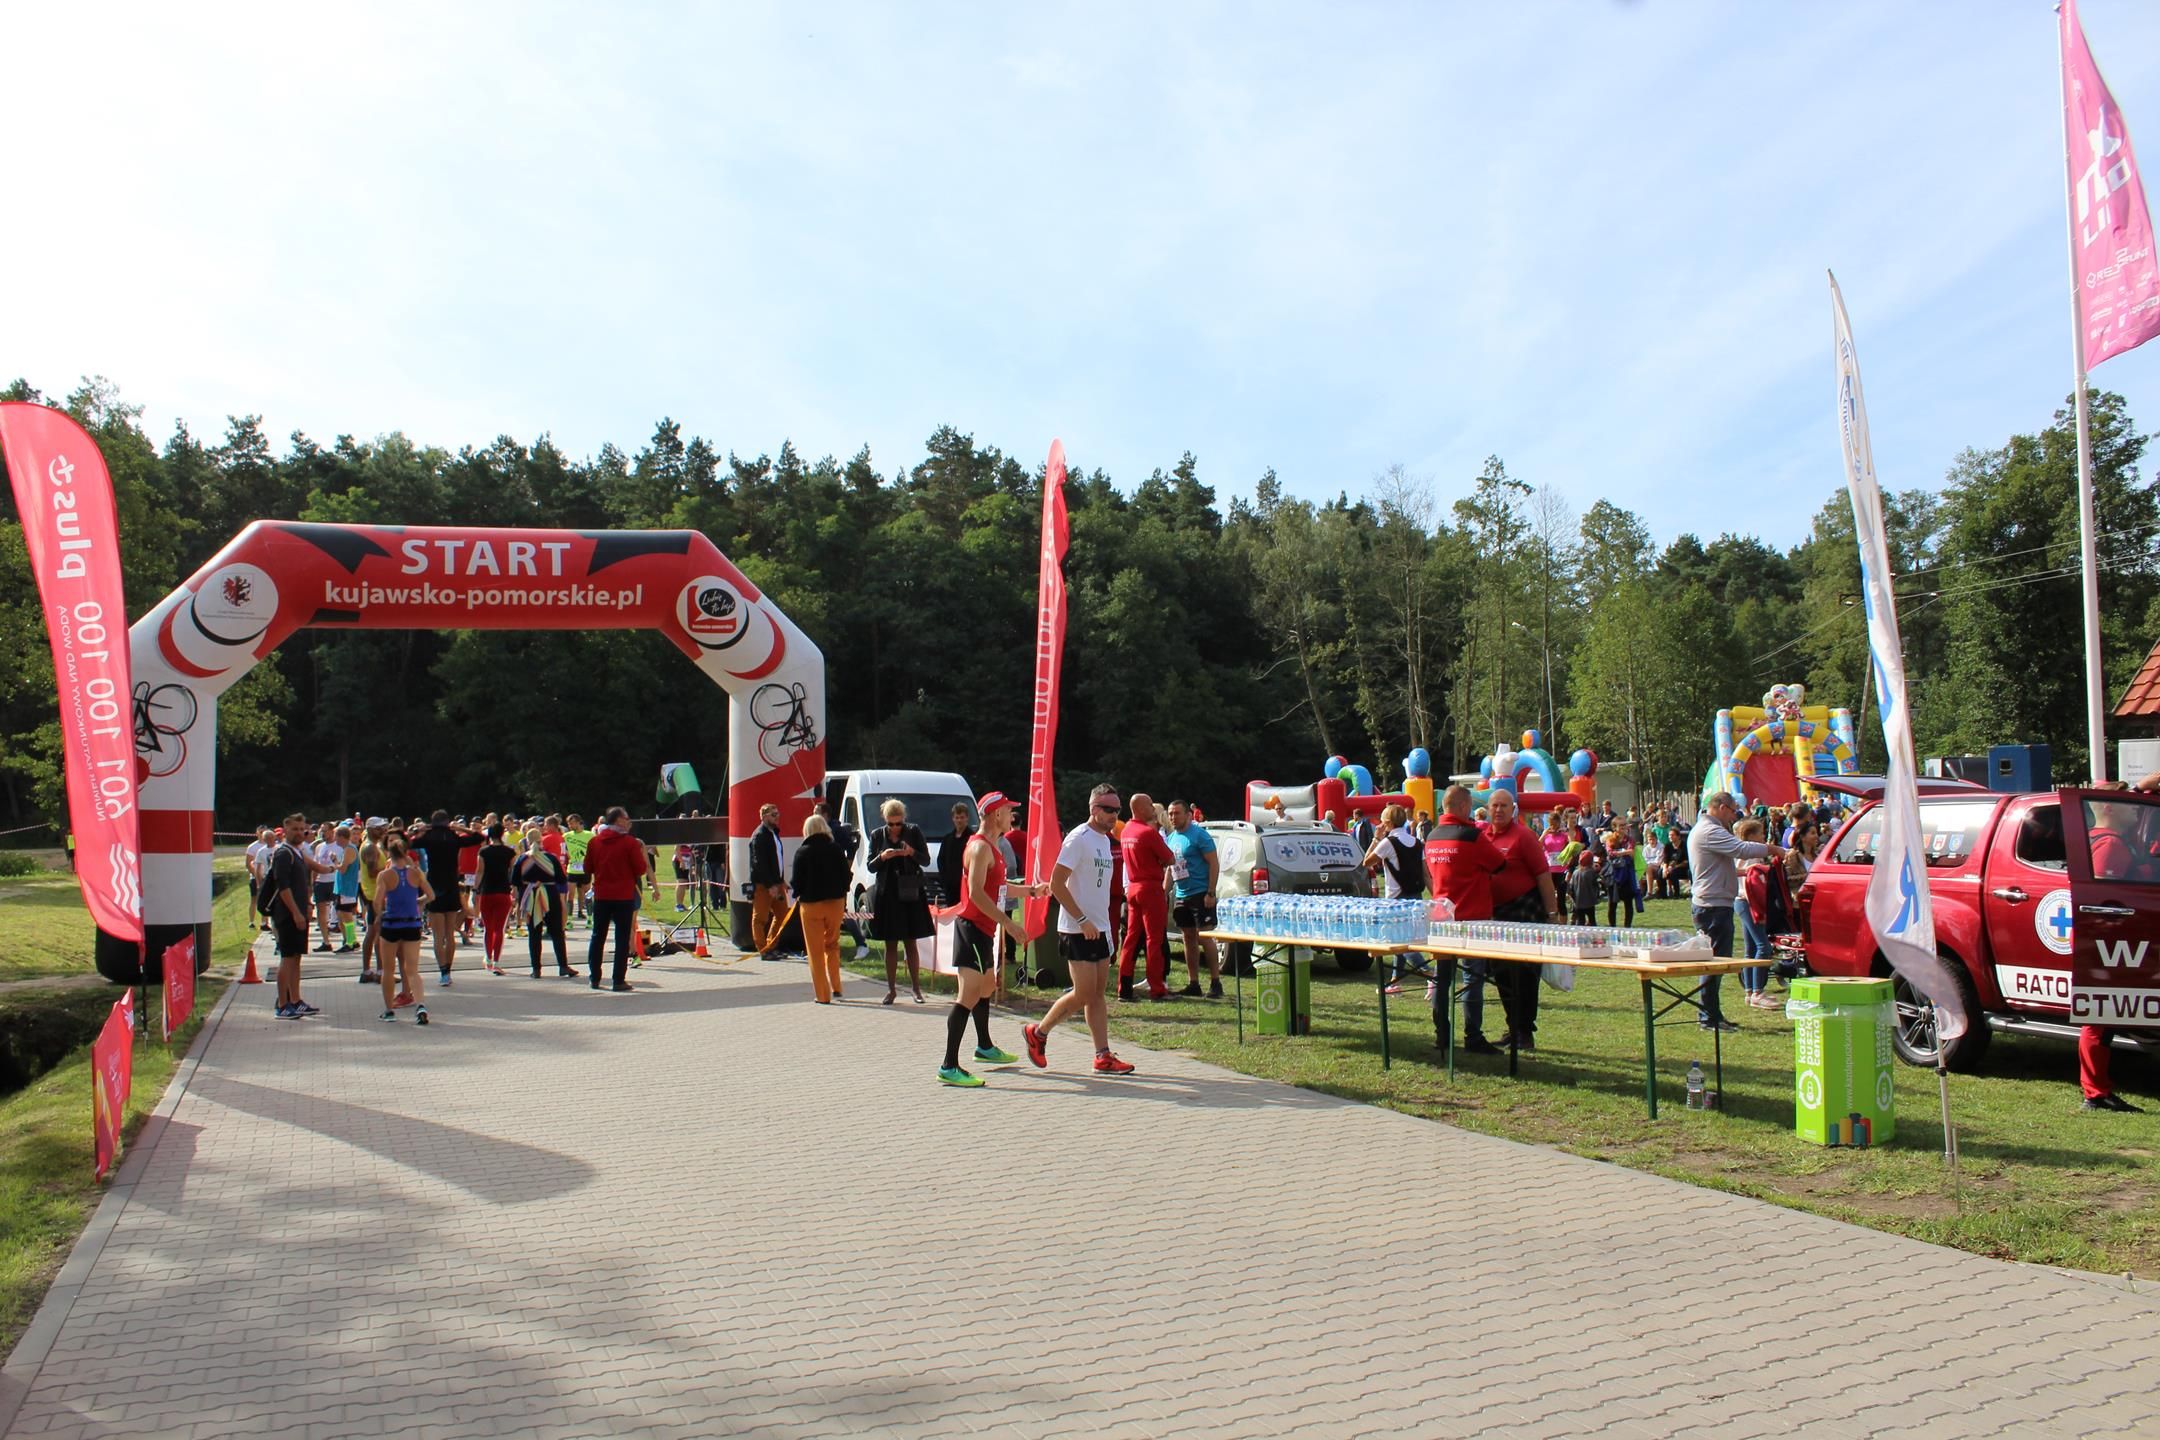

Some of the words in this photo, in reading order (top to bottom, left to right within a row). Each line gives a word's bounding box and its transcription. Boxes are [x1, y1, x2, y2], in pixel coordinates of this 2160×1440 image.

[400, 539, 571, 577] START
[324, 579, 642, 610] kujawsko-pomorskie.pl
[1300, 846, 1354, 858] WOPR
[2016, 972, 2069, 998] RATO
[2072, 992, 2160, 1020] CTWO
